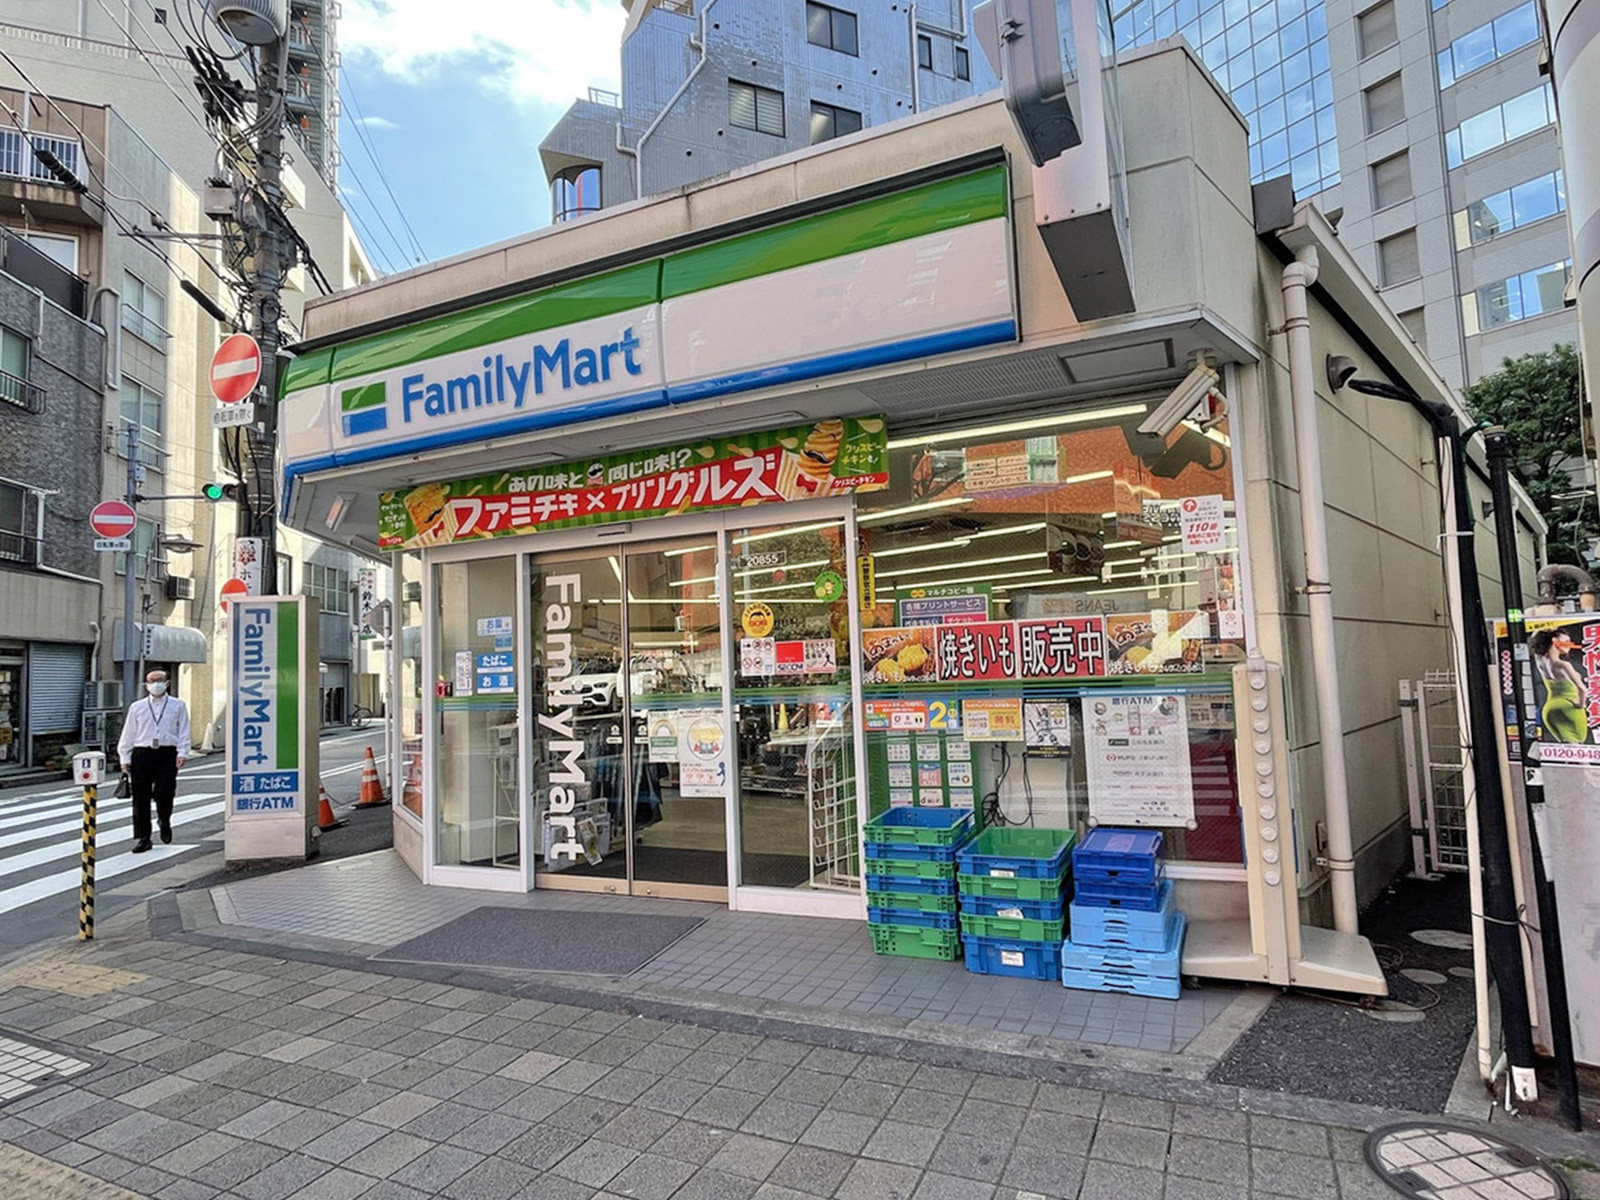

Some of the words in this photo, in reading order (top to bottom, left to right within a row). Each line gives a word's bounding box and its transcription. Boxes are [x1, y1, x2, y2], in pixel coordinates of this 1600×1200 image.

[402, 327, 641, 423] FamilyMart
[508, 473, 584, 493] あの味と
[747, 554, 779, 567] 20855
[482, 655, 508, 667] たばこ
[939, 624, 1016, 681] 焼きいも
[1021, 620, 1103, 678] 販売中
[240, 608, 271, 765] FamilyMart
[538, 573, 586, 862] FamilyMart
[929, 701, 948, 729] 2
[239, 776, 255, 791] 酒
[260, 775, 291, 789] たばこ
[236, 797, 294, 811] 銀行ATM
